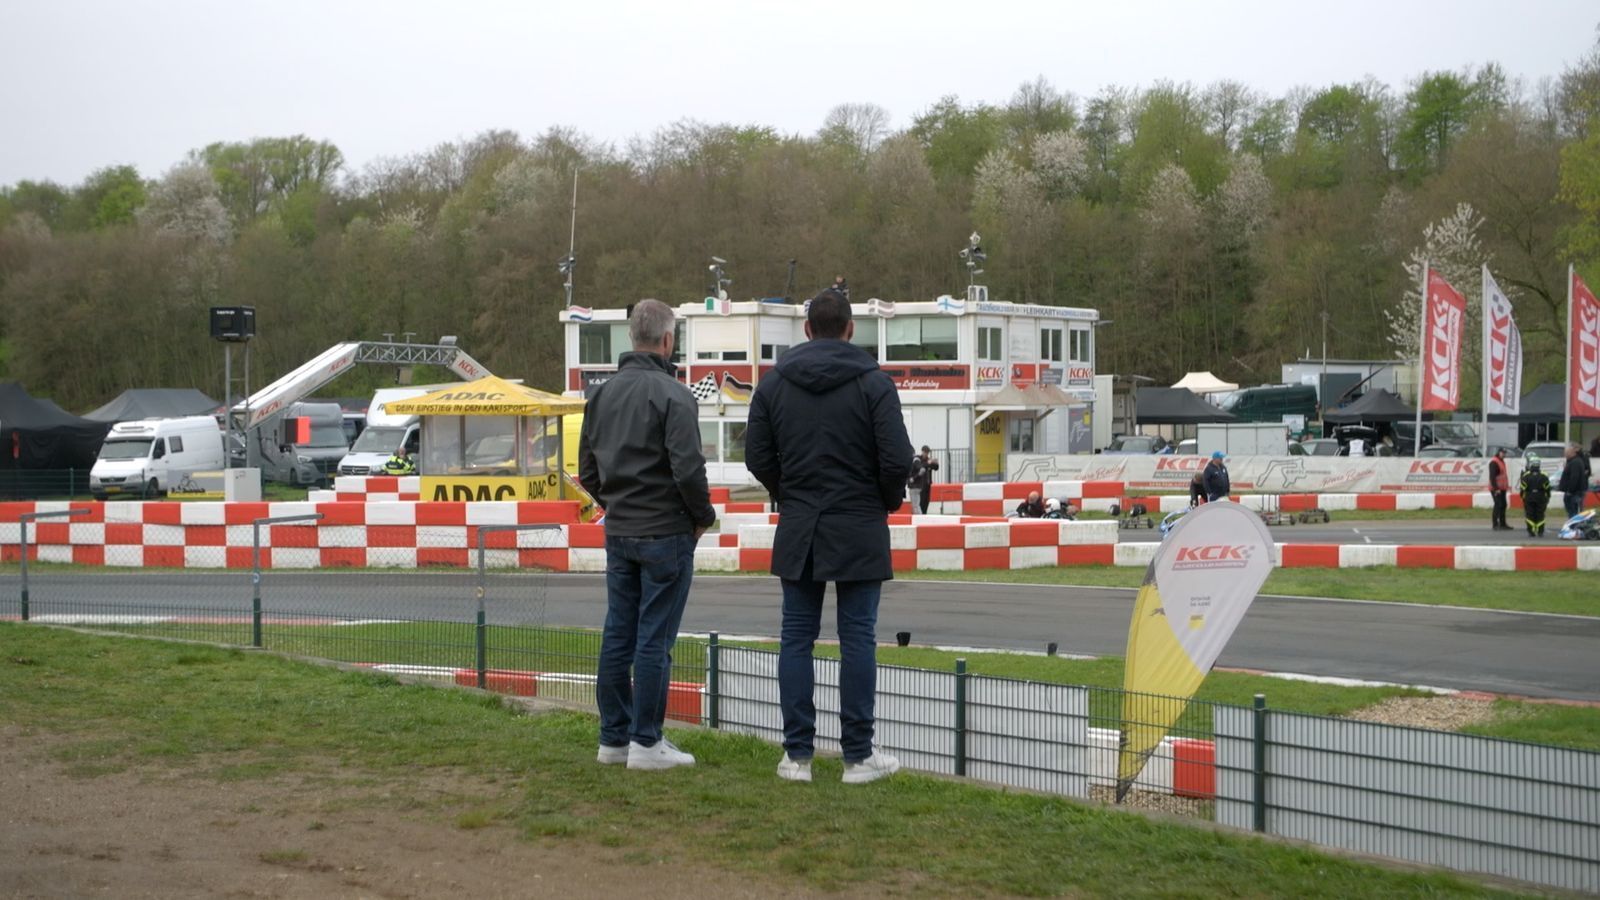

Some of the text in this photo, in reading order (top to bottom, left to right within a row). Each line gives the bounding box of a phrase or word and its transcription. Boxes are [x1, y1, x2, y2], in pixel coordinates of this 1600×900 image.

[1431, 305, 1450, 401] KCK
[1490, 307, 1509, 404] KCK
[1578, 309, 1598, 408] KCK
[977, 367, 1001, 378] KCK
[1069, 367, 1090, 378] KCK
[436, 392, 505, 401] ADAC
[416, 404, 452, 412] EINSTIEG
[464, 404, 481, 412] DEN
[482, 404, 528, 412] KARTSPORT
[981, 417, 1001, 434] ADAC
[1409, 460, 1478, 473] KCK
[433, 484, 516, 501] ADAC
[528, 480, 547, 500] ADAC
[1175, 545, 1246, 561] KCK
